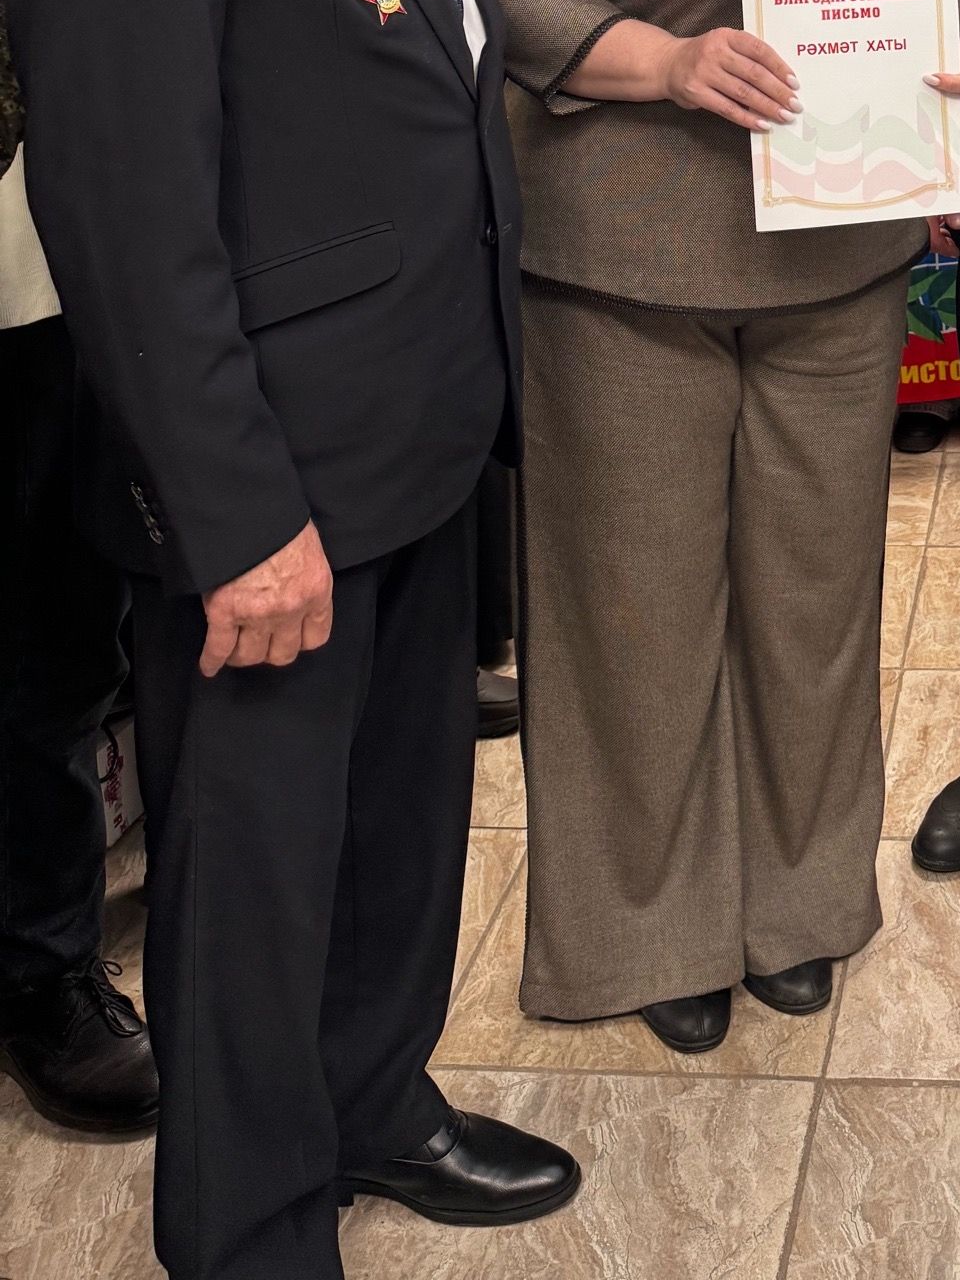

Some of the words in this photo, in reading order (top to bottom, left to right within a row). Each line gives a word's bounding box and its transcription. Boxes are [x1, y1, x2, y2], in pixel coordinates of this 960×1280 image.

[821, 7, 881, 20] ПИСЬМО
[797, 41, 858, 56] РӘХМӘТ
[866, 39, 907, 52] ХАТЫ
